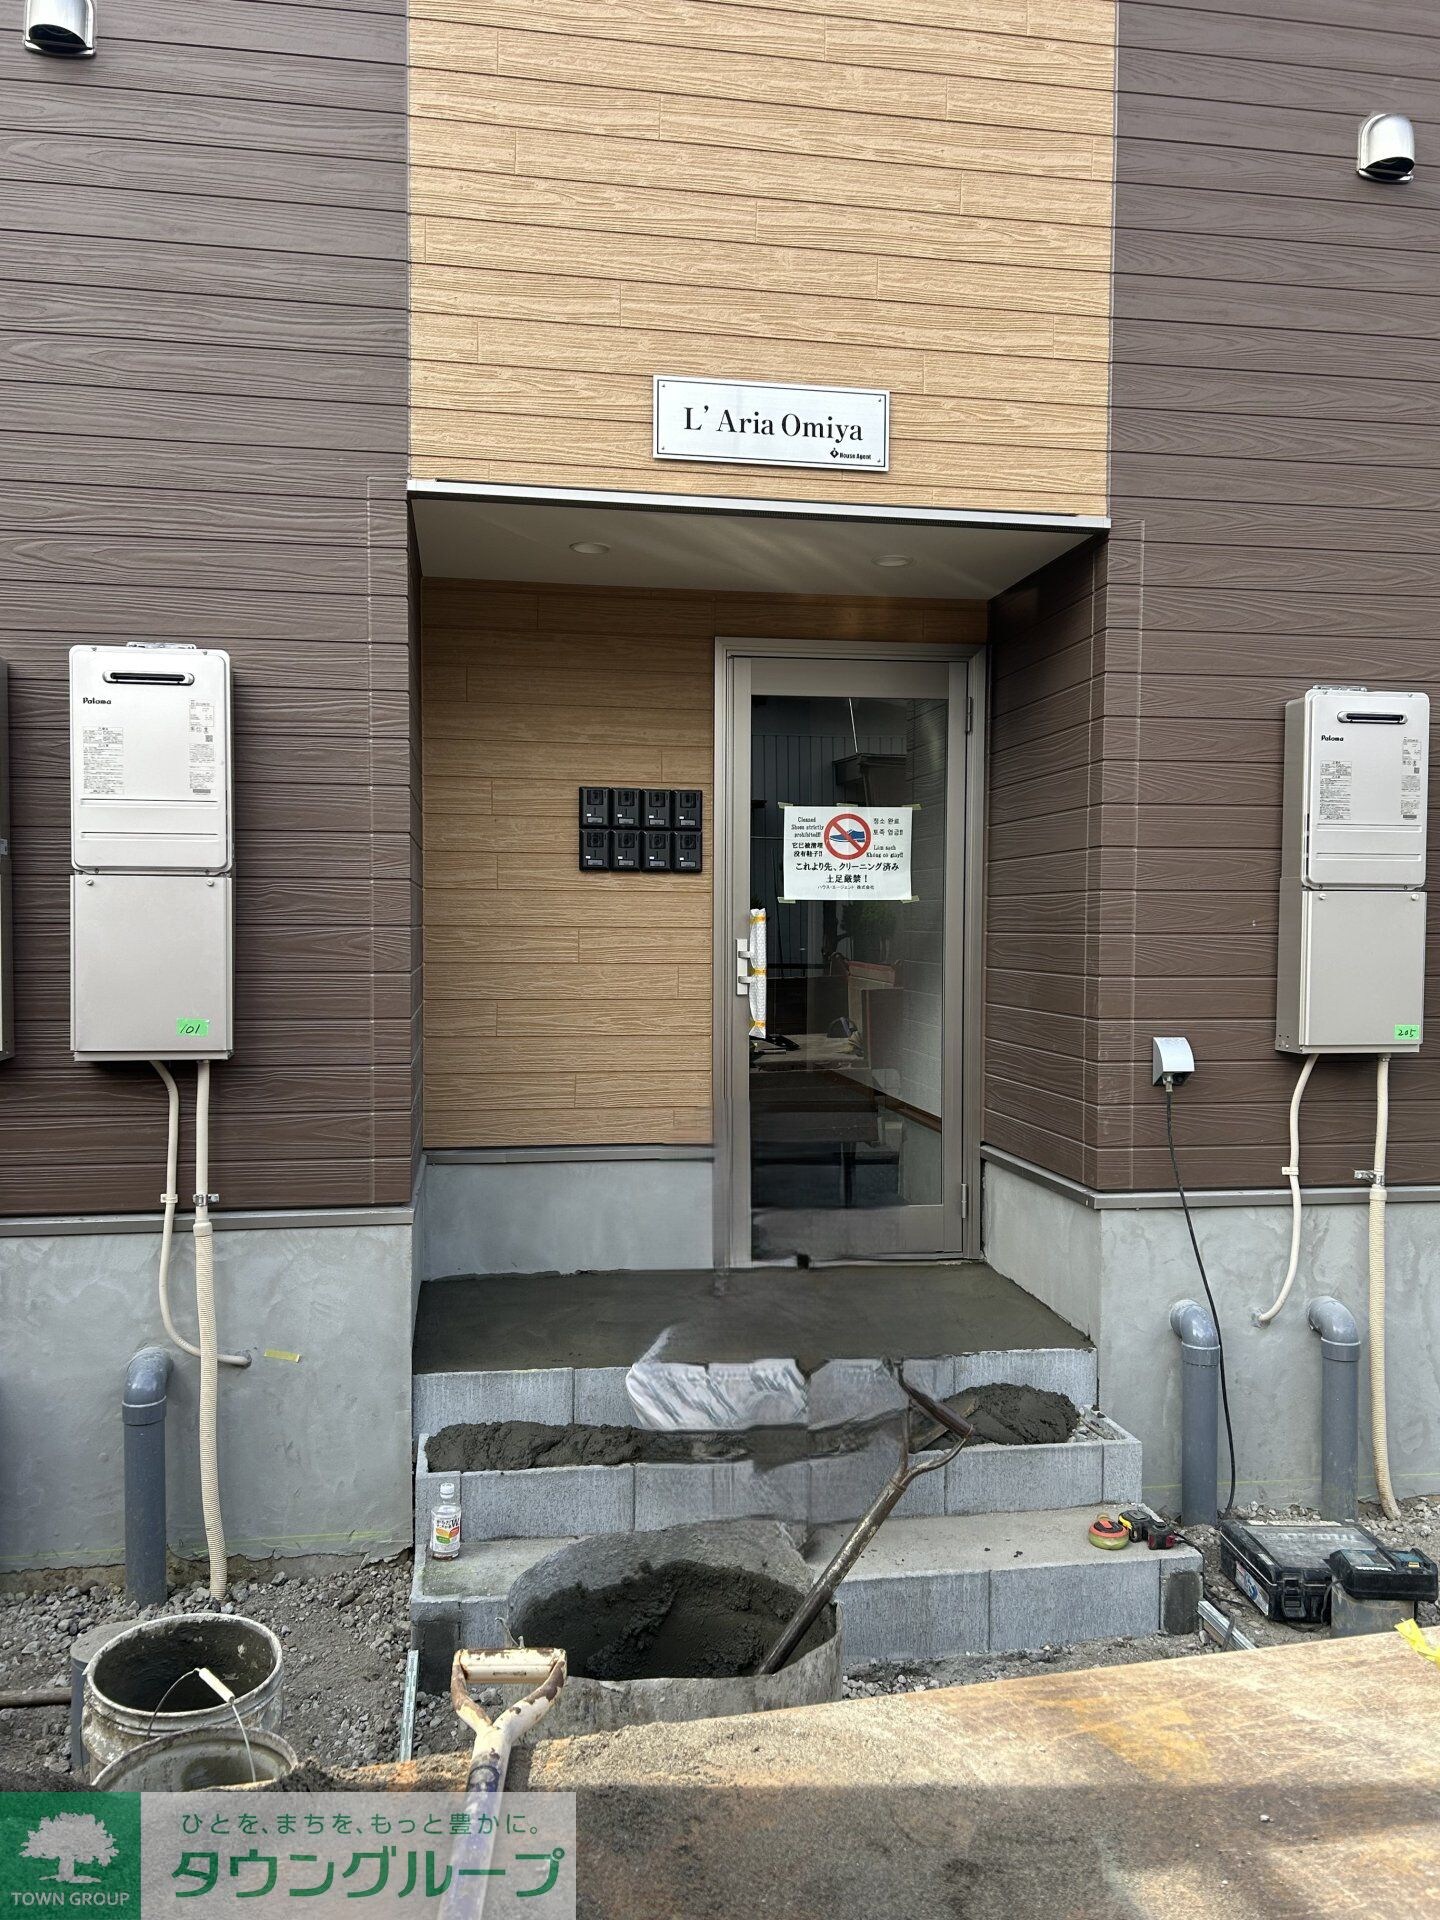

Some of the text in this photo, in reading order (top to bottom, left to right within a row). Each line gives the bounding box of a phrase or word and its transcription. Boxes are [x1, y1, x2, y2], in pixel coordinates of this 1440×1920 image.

[781, 413, 864, 444] Omiya
[82, 697, 112, 705] Paloma
[1320, 734, 1345, 742] Paloma
[795, 862, 900, 872] これより先、クリーニング済み
[179, 1023, 201, 1034] 101
[1398, 1028, 1417, 1037] 205
